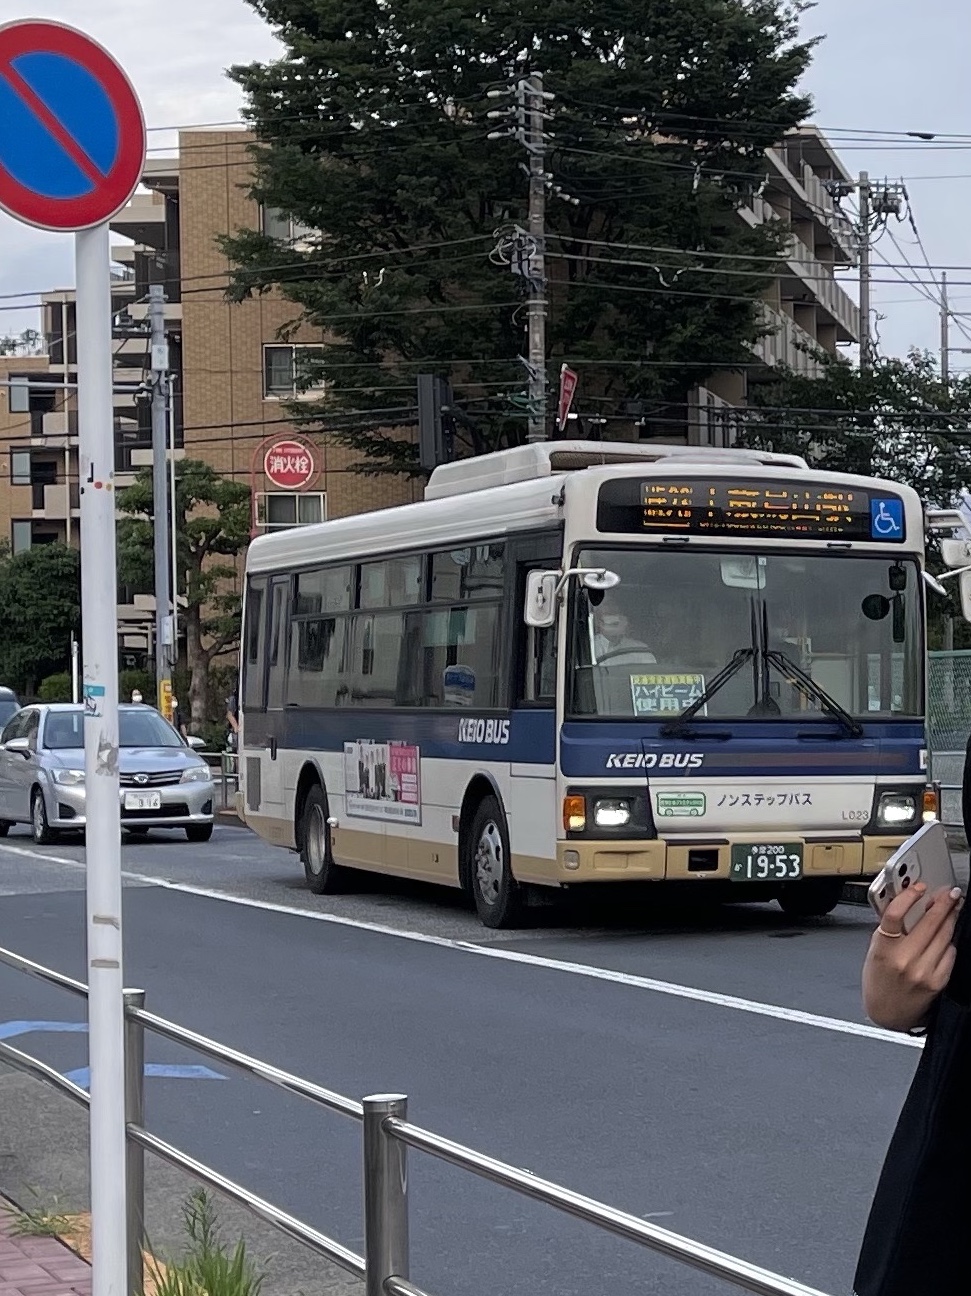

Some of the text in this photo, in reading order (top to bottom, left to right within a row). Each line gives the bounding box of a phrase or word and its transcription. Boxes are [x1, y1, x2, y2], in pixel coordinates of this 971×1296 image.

[270, 455, 309, 473] 消火栓
[459, 718, 510, 744] KEIO BUS
[606, 753, 704, 768] KEIO BUS
[717, 793, 813, 806] ノンステップバス
